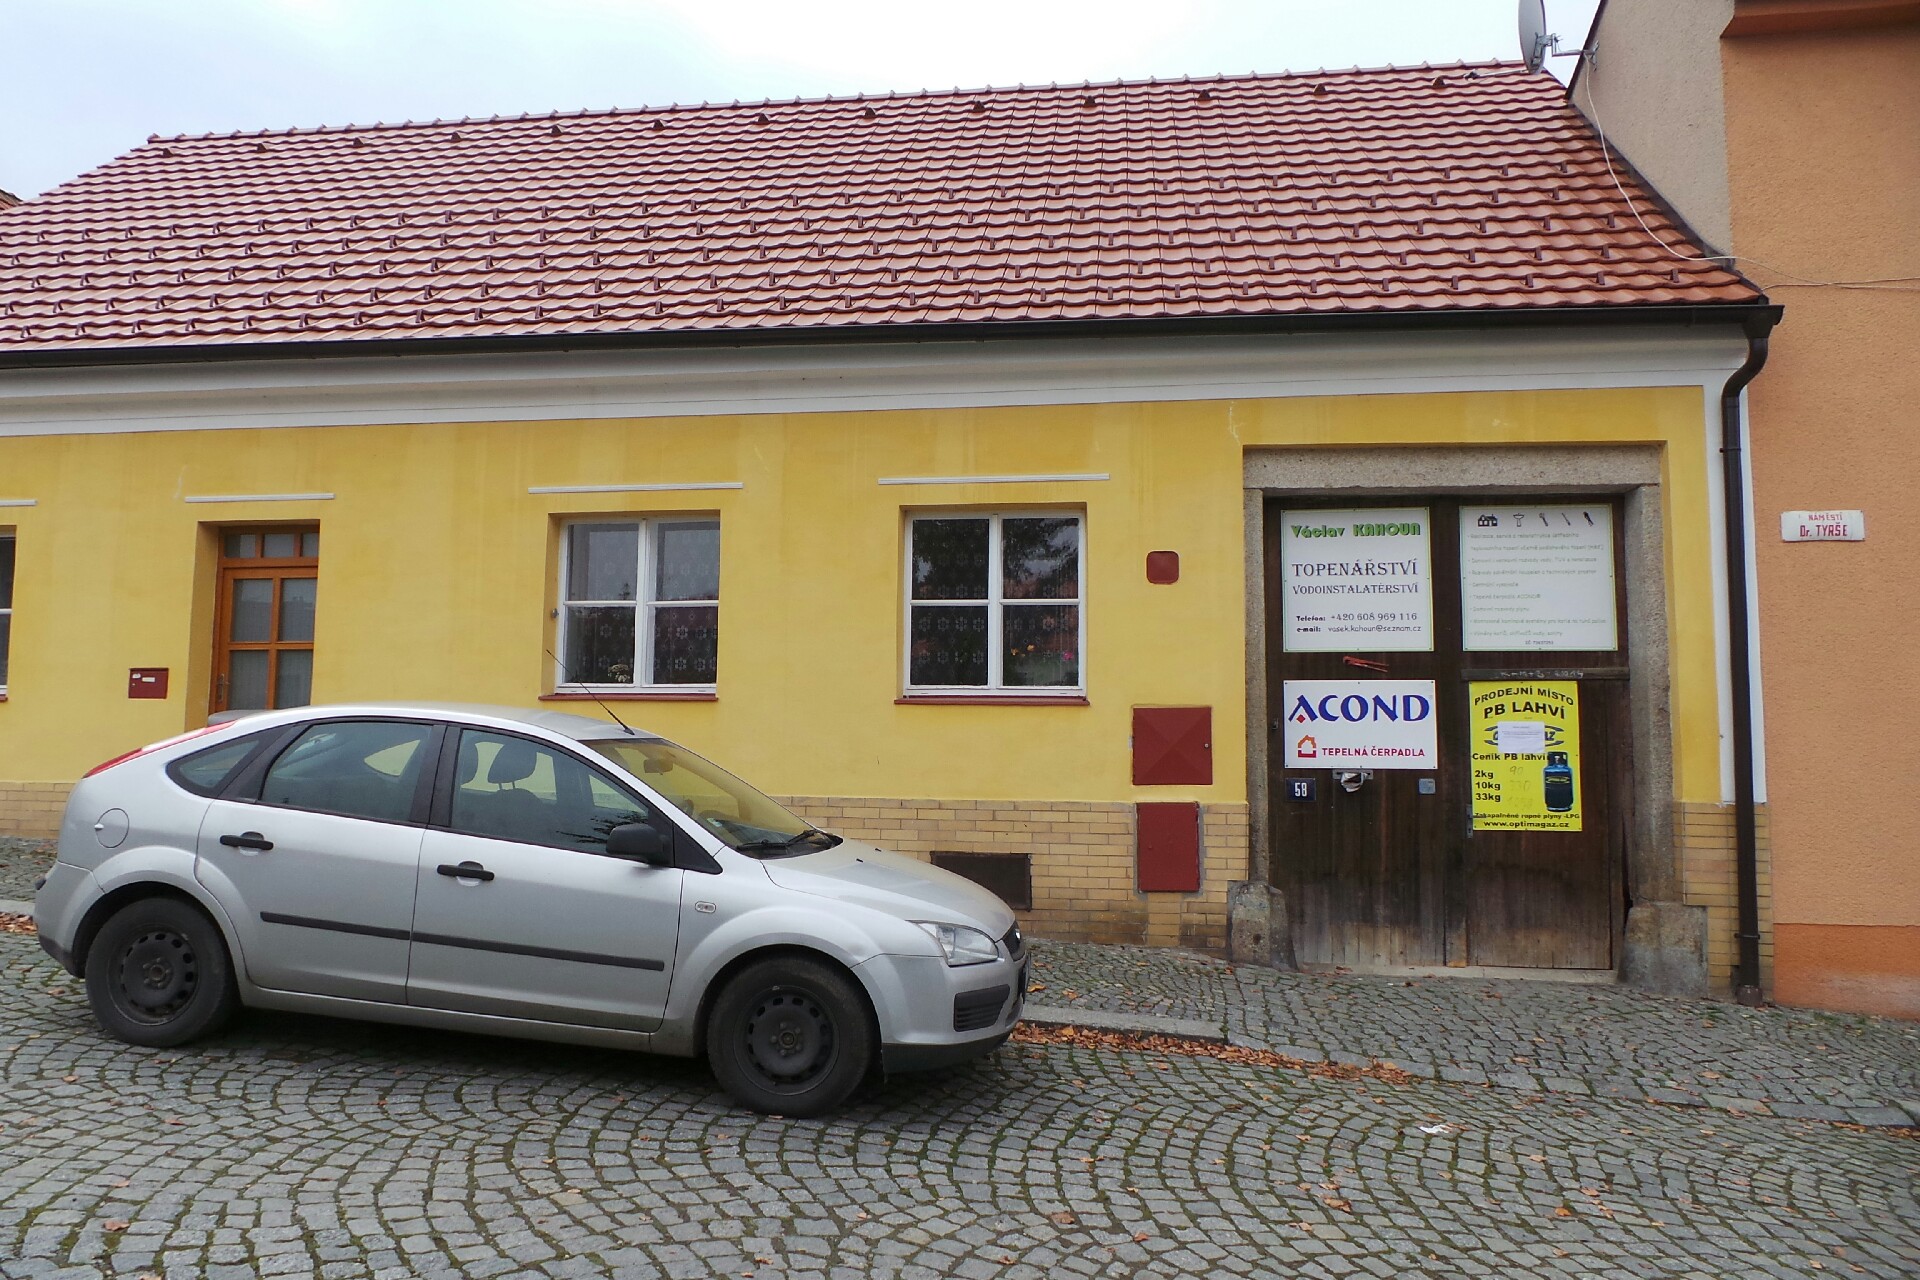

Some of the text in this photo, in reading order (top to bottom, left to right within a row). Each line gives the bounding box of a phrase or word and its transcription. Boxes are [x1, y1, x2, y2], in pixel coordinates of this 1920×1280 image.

[1291, 523, 1421, 538] Václav KAHOUN
[1799, 522, 1848, 537] Dr. TYRŠE
[1291, 558, 1419, 577] TOPENÁŘSTVÍ
[1330, 613, 1355, 621] +420
[1357, 612, 1375, 621] 608
[1377, 612, 1396, 622] 969
[1399, 612, 1418, 621] 116
[1474, 685, 1574, 706] PRODEJNÍ MÍSTO
[1288, 694, 1430, 723] ACOND
[1483, 701, 1566, 720] PB LAHVÍ
[1321, 745, 1425, 757] TEPELNÁ ČERPADLA
[1504, 752, 1519, 761] PB
[1474, 770, 1494, 780] 2kg
[1294, 782, 1308, 797] 58
[1475, 781, 1501, 792] 10kg
[1475, 792, 1501, 803] 33kg
[1483, 820, 1570, 830] www.optimagaz.cz
